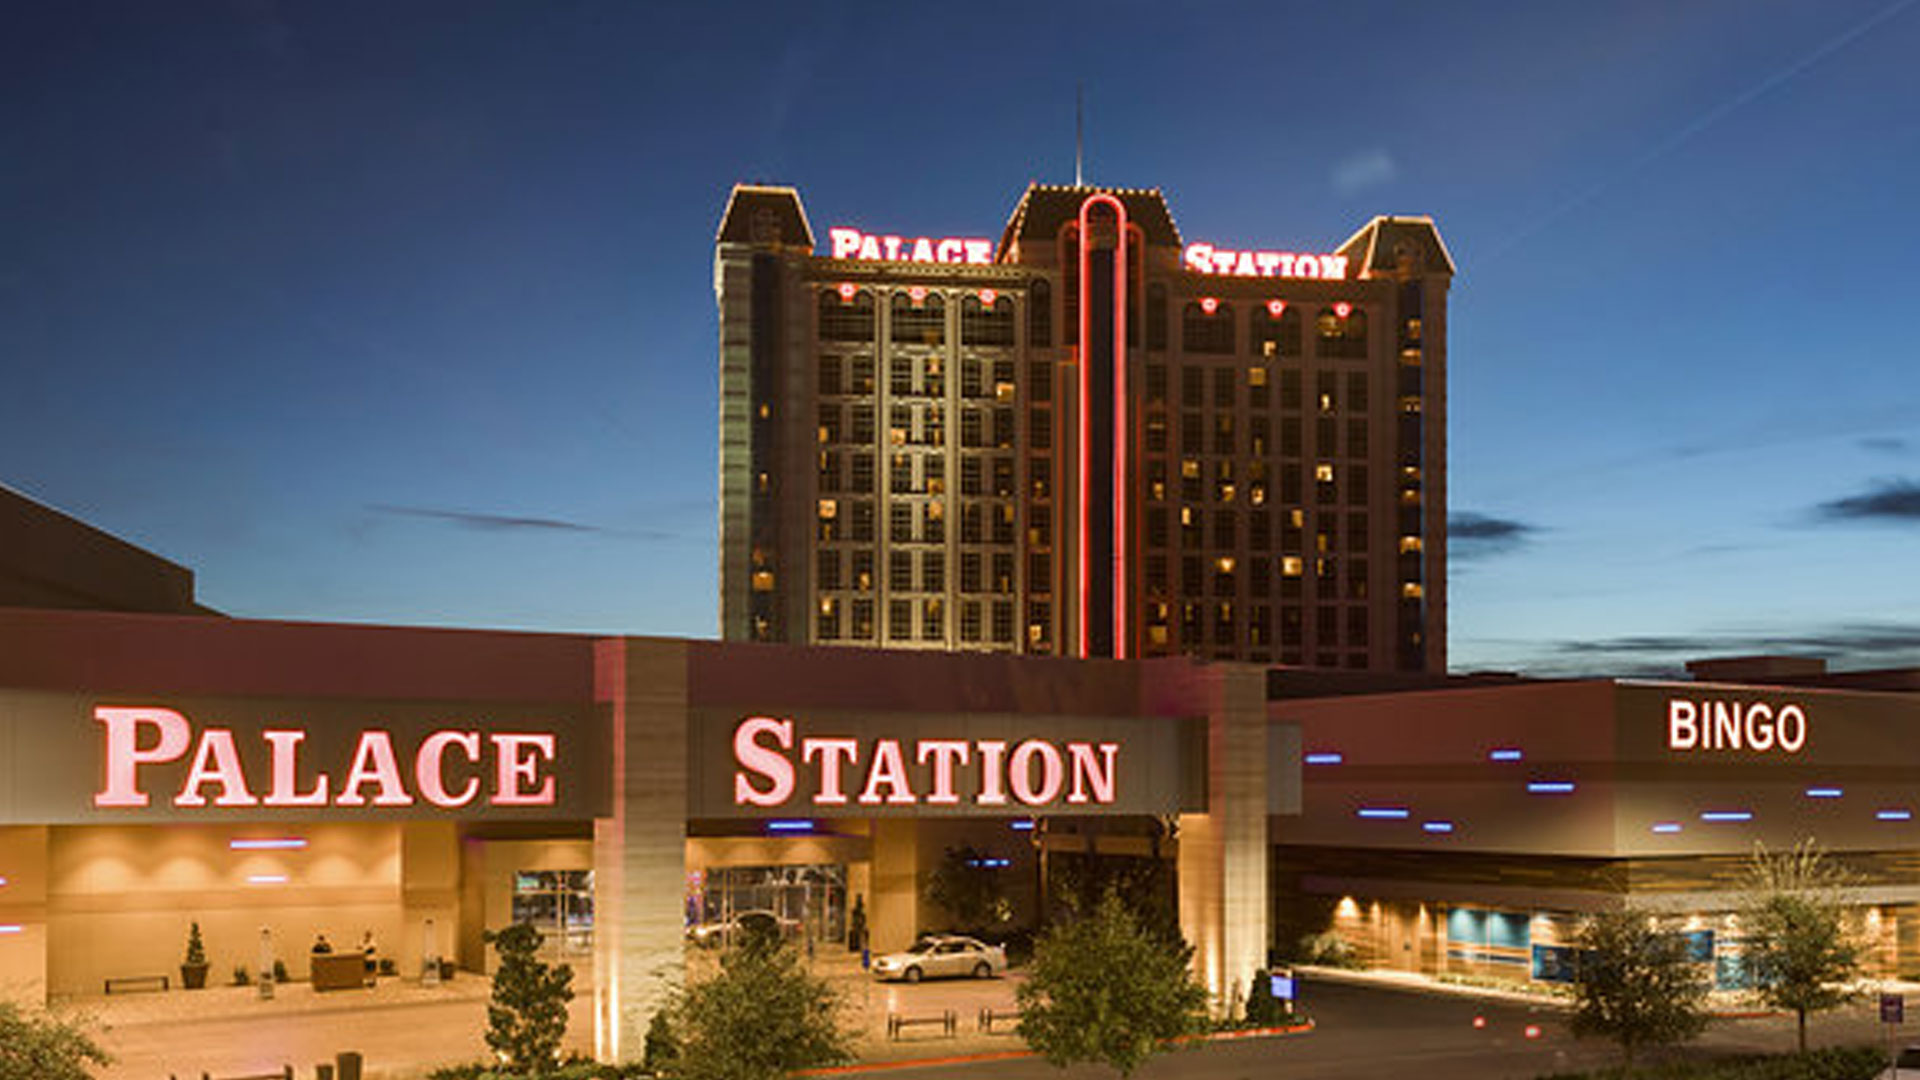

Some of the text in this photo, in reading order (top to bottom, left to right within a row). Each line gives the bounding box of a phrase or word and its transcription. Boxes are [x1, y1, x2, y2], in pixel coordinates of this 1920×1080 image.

[830, 227, 1348, 281] PALACE STATION
[1669, 700, 1806, 752] BINGO
[94, 706, 1118, 808] PALACE STATION
